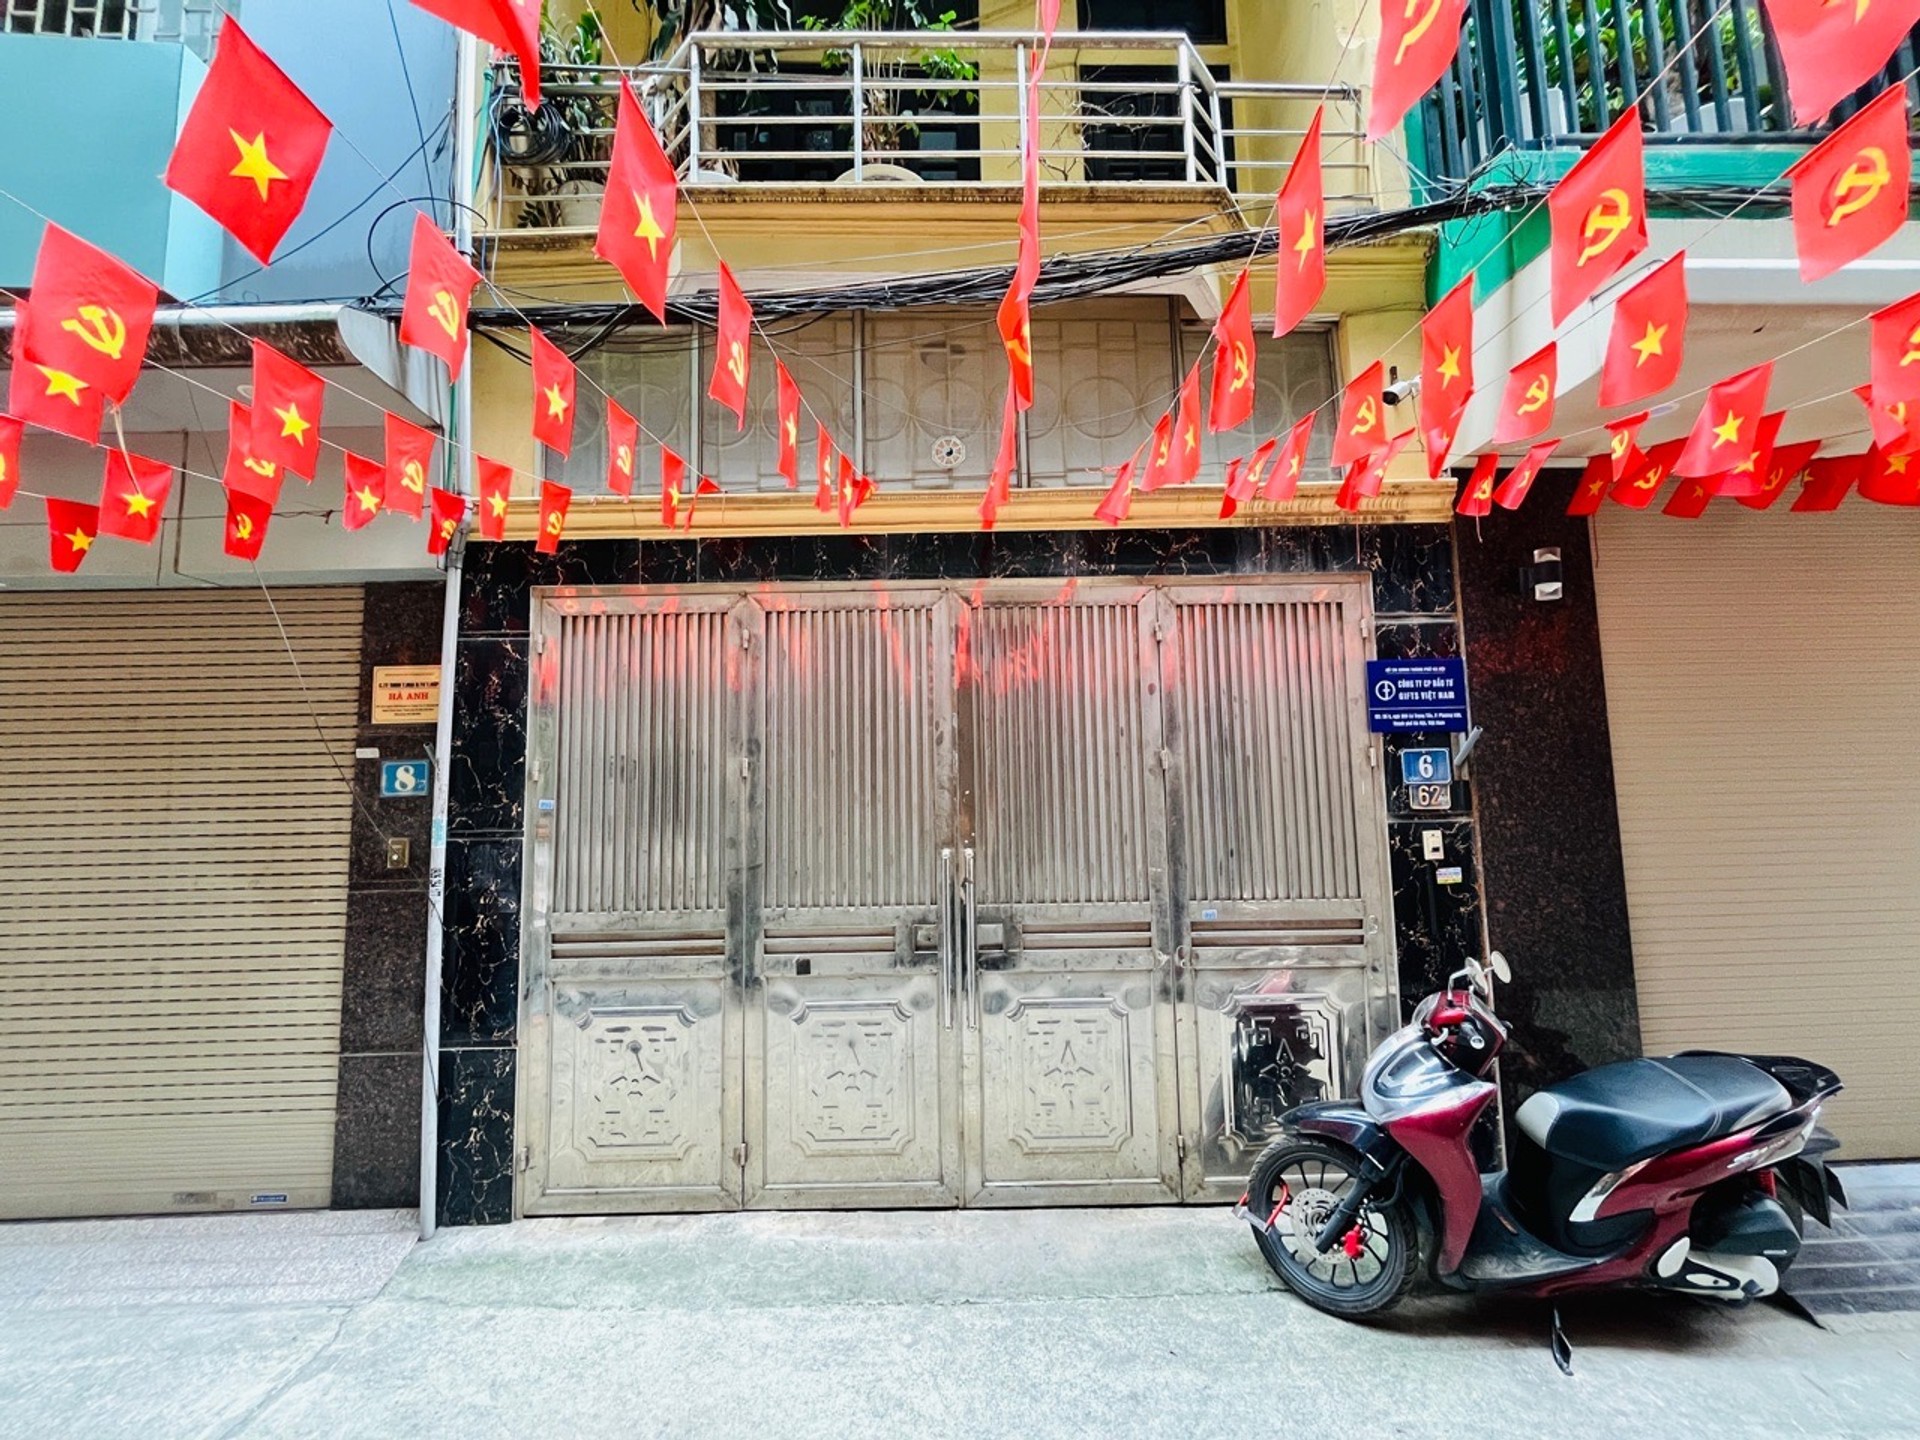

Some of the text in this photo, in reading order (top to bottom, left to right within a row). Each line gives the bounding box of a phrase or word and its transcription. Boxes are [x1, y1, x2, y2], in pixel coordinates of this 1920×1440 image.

[406, 692, 429, 701] ANH
[1420, 690, 1436, 701] VIỆT
[1438, 691, 1455, 700] NAM
[1418, 754, 1434, 779] 6
[394, 764, 416, 792] 8
[1417, 785, 1441, 806] 62
